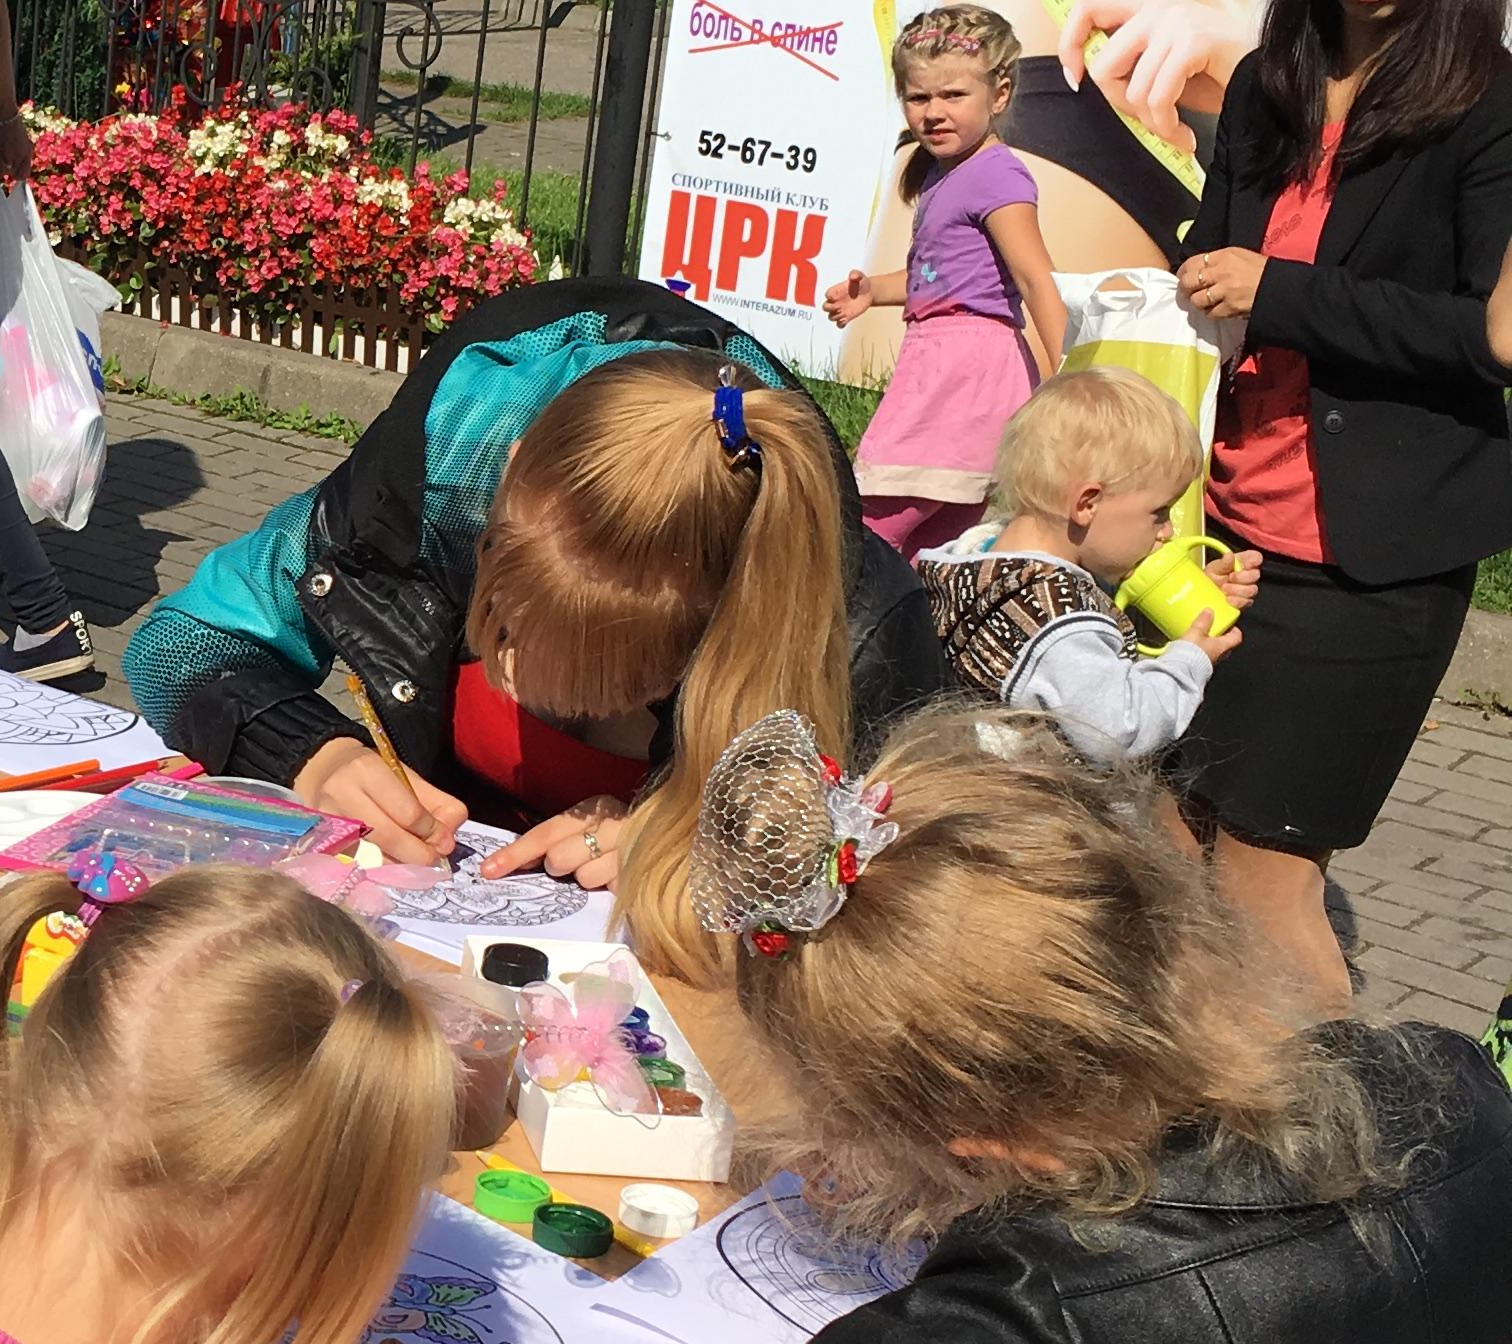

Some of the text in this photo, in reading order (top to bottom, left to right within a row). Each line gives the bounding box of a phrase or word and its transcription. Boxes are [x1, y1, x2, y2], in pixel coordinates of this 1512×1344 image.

[689, 2, 743, 42] боль
[770, 20, 838, 56] спине
[697, 129, 818, 173] 52-67-39
[671, 172, 830, 212] СПОРТИВНЫЙ КЛУБ
[660, 189, 829, 308] ЦРК
